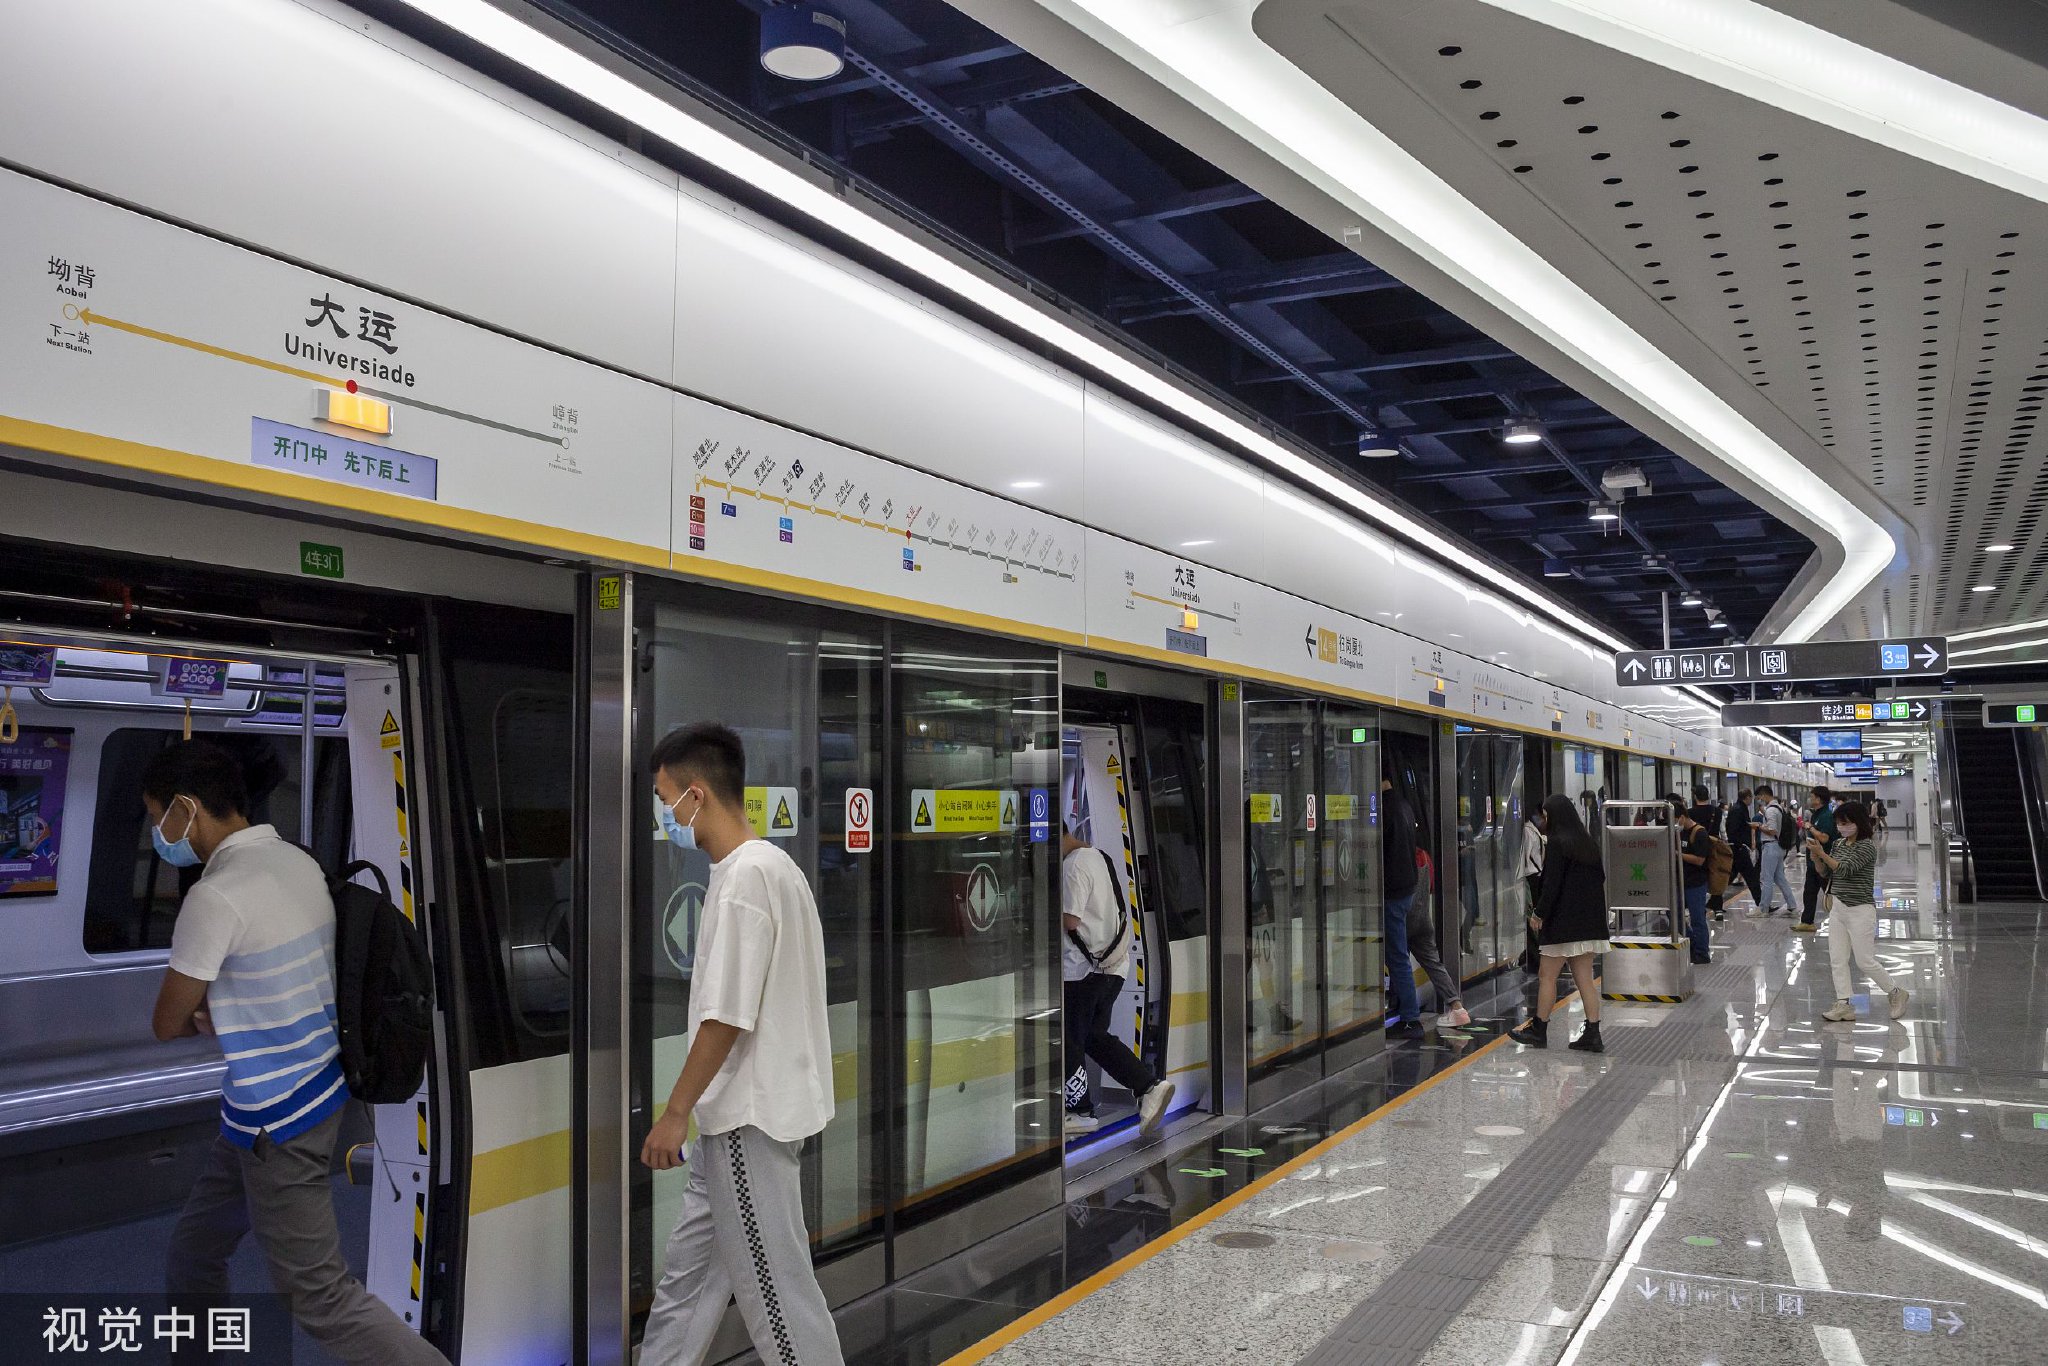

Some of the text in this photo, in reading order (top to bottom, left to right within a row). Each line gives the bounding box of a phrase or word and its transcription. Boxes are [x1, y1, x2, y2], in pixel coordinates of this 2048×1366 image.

[47, 256, 96, 288] 坳背
[56, 284, 87, 300] Aobei
[49, 323, 90, 345] 下一站
[305, 292, 399, 355] 大运
[46, 338, 92, 355] Next Station
[285, 333, 415, 388] Universiade
[273, 436, 411, 484] 开门中 先下后上
[305, 550, 340, 572] 4车3门
[1175, 565, 1196, 589] 大运
[605, 582, 618, 595] 17
[1170, 586, 1201, 604] Universiade
[1884, 650, 1894, 664] 3
[1822, 704, 1855, 715] 往沙田
